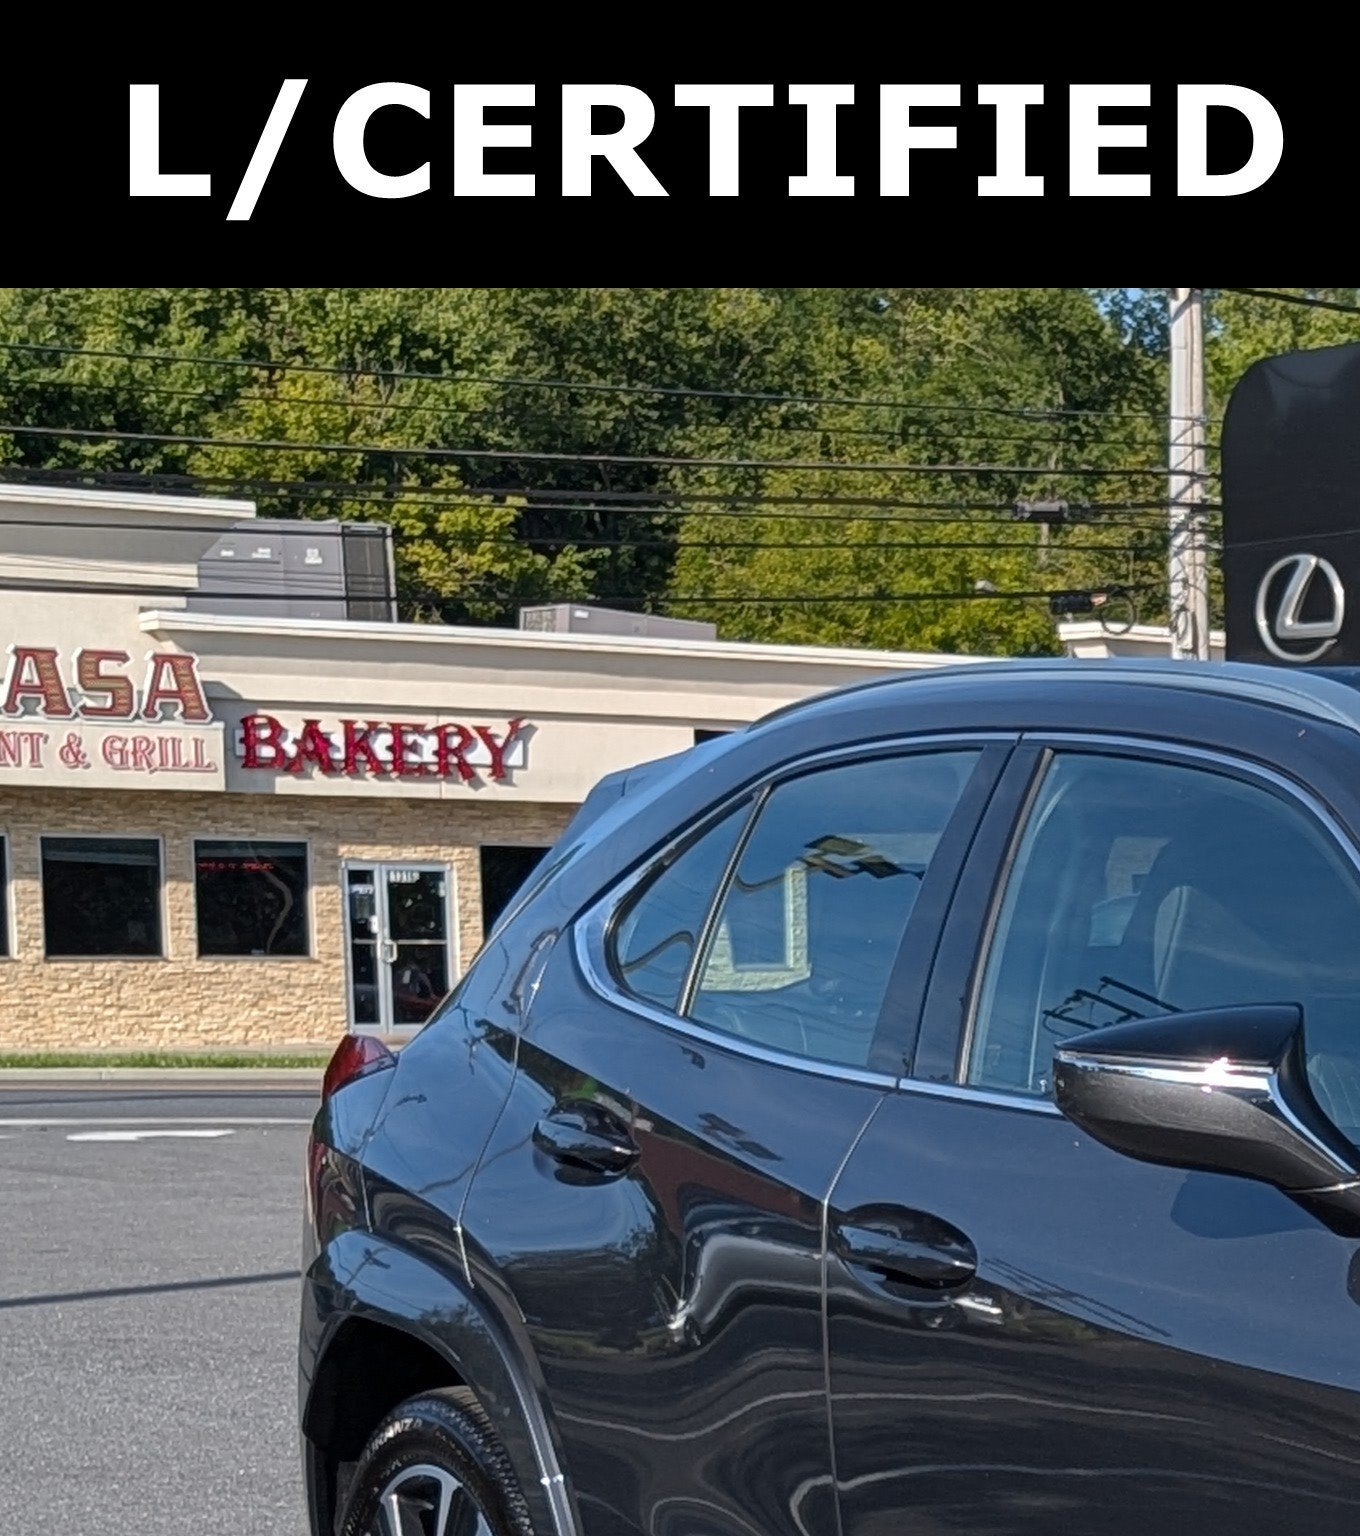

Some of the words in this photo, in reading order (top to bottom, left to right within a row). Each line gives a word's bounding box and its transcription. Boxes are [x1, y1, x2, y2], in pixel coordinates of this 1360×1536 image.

[58, 731, 90, 769] &
[102, 734, 217, 775] GRILL
[240, 713, 529, 783] BAKERY
